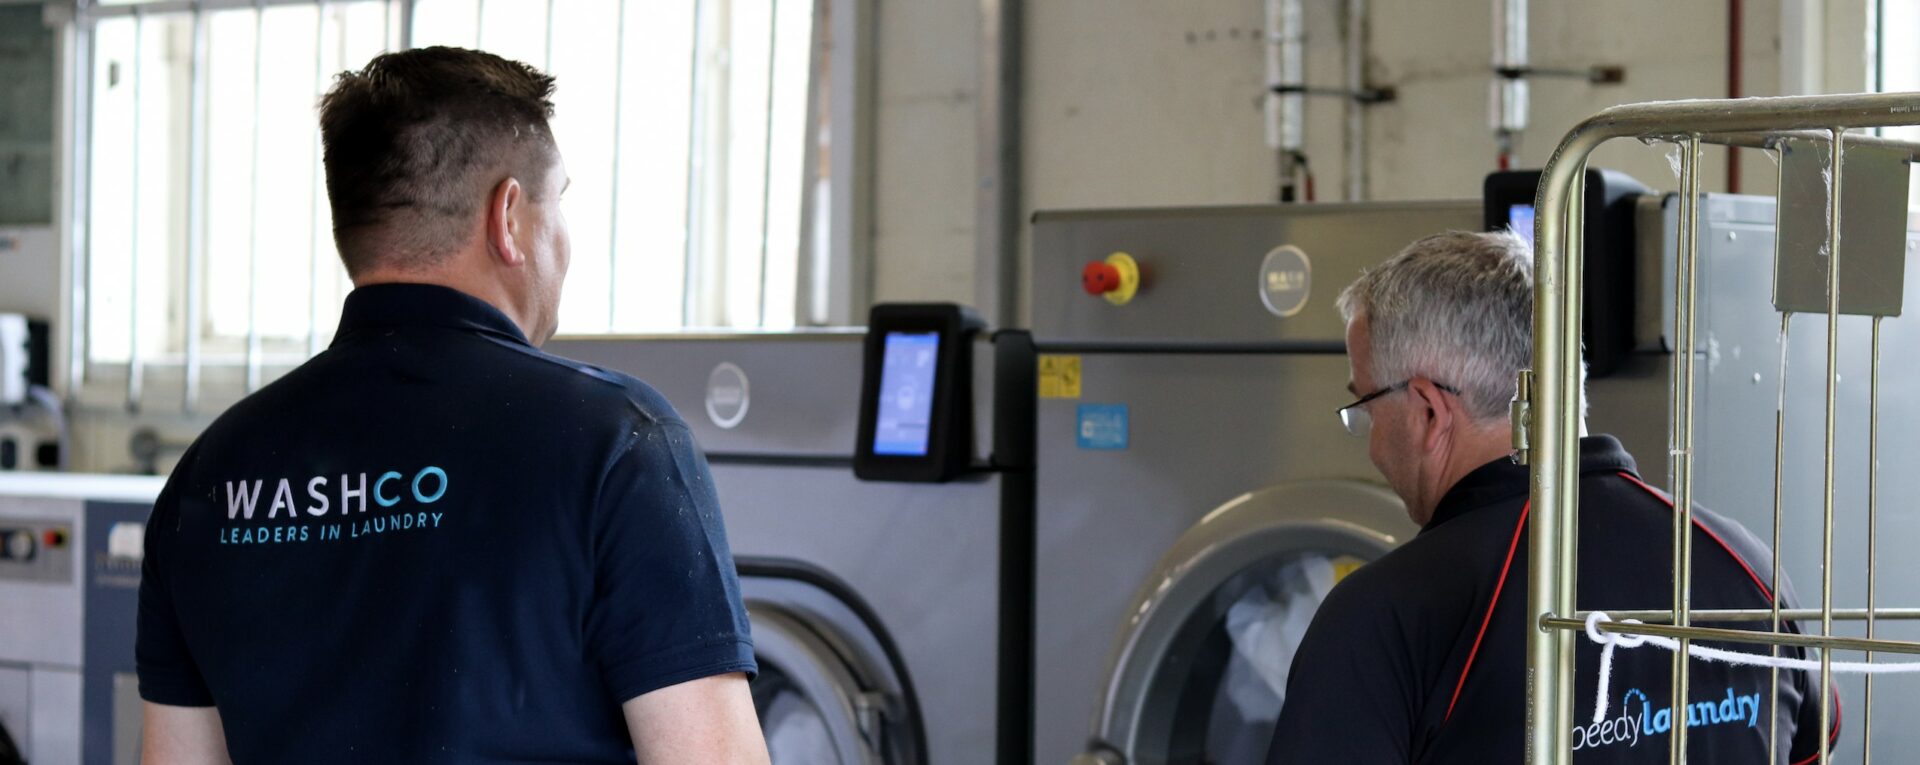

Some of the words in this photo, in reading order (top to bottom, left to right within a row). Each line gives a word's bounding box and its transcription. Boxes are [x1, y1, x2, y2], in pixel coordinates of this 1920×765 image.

[226, 466, 447, 519] WASHCO
[220, 526, 309, 544] LEADERS
[320, 525, 341, 541] IN
[351, 512, 443, 537] LAUNDRY
